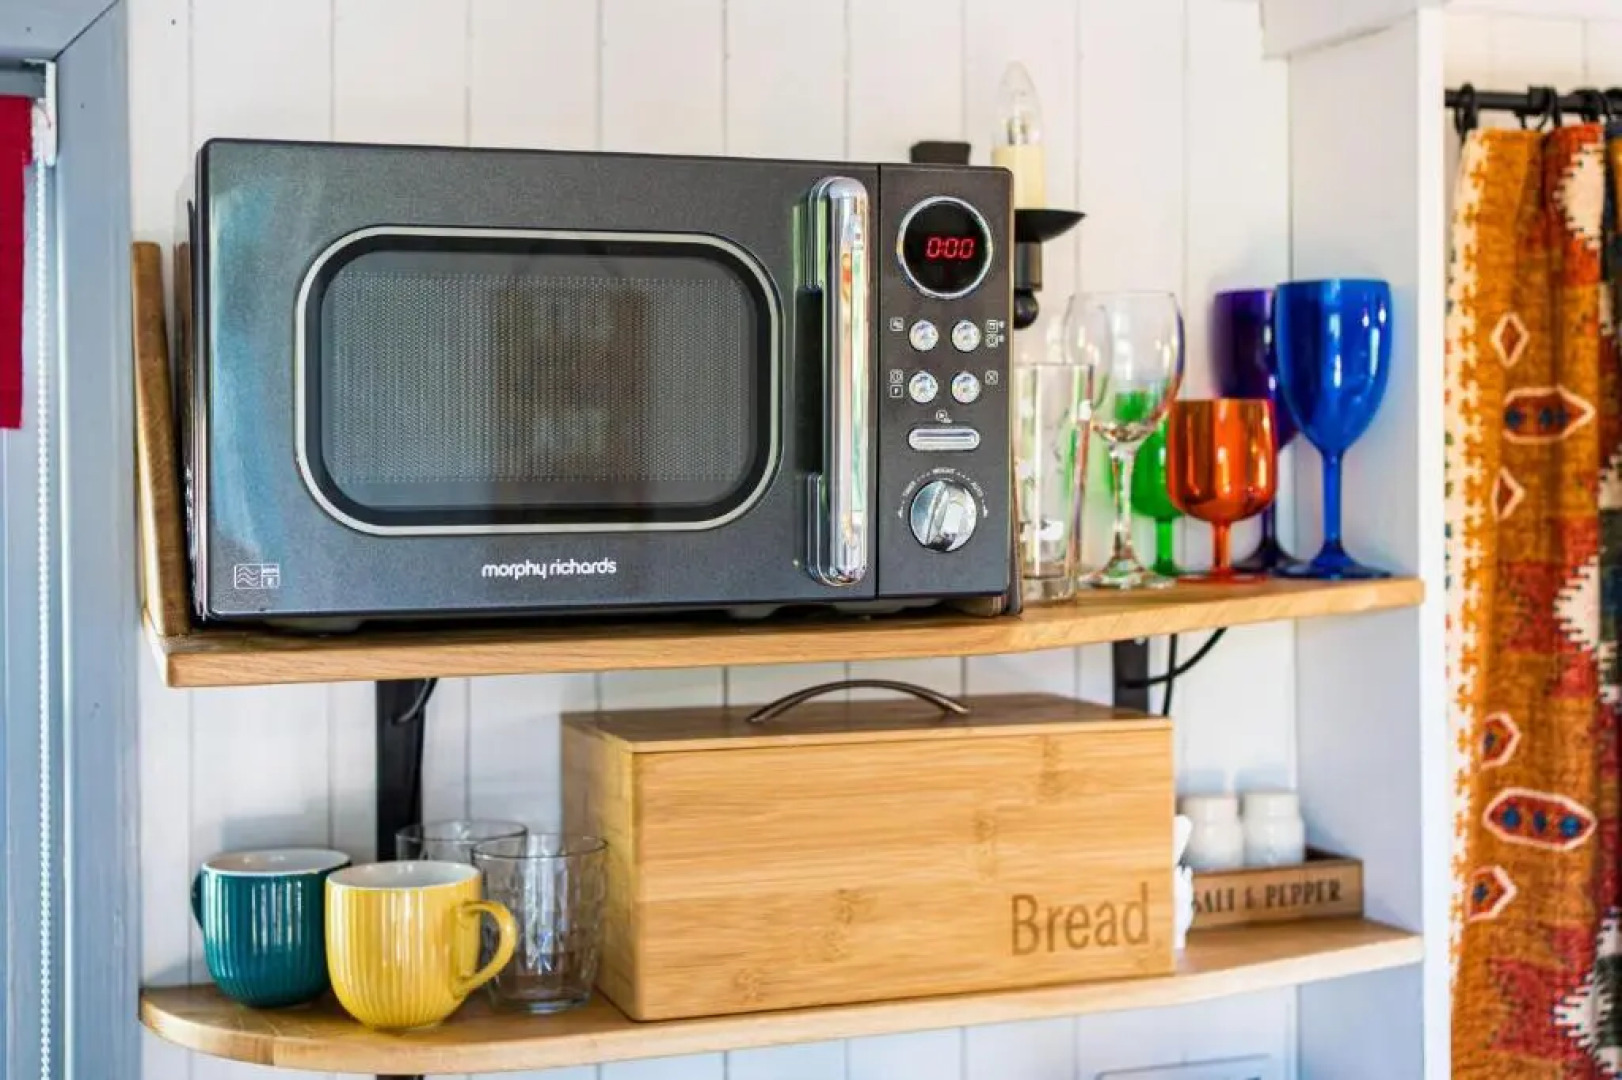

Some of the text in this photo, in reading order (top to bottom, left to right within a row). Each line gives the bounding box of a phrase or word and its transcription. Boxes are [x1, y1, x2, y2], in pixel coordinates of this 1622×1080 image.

[926, 236, 975, 259] 0:00
[481, 557, 617, 580] morphy richards
[1265, 879, 1341, 908] PEPPER
[1011, 881, 1149, 957] Bread
